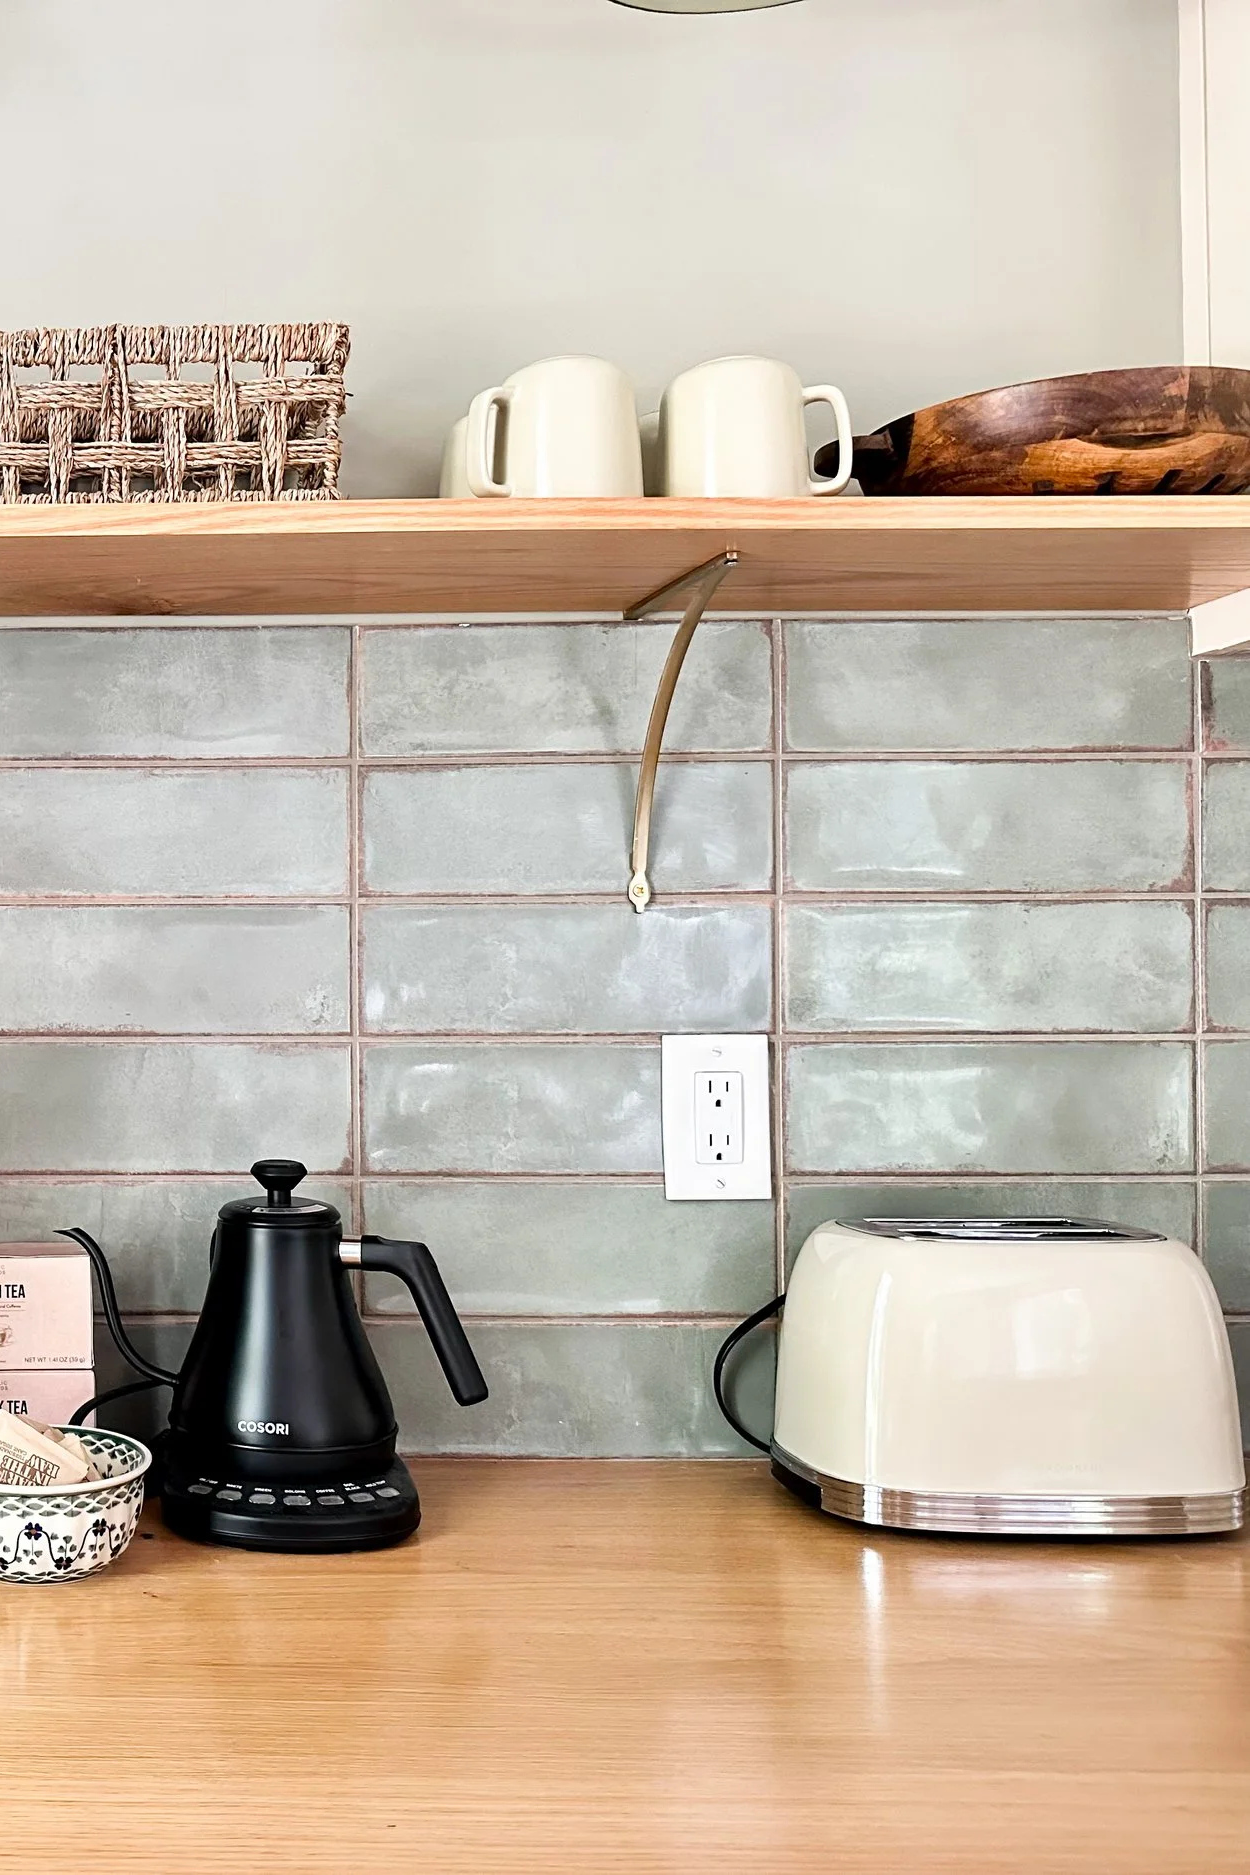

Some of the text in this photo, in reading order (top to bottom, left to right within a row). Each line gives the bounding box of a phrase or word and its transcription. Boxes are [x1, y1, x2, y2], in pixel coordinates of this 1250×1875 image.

[4, 1284, 26, 1299] TEA
[7, 1400, 28, 1415] TEA
[237, 1420, 290, 1436] COSORI
[28, 1454, 60, 1479] RAW
